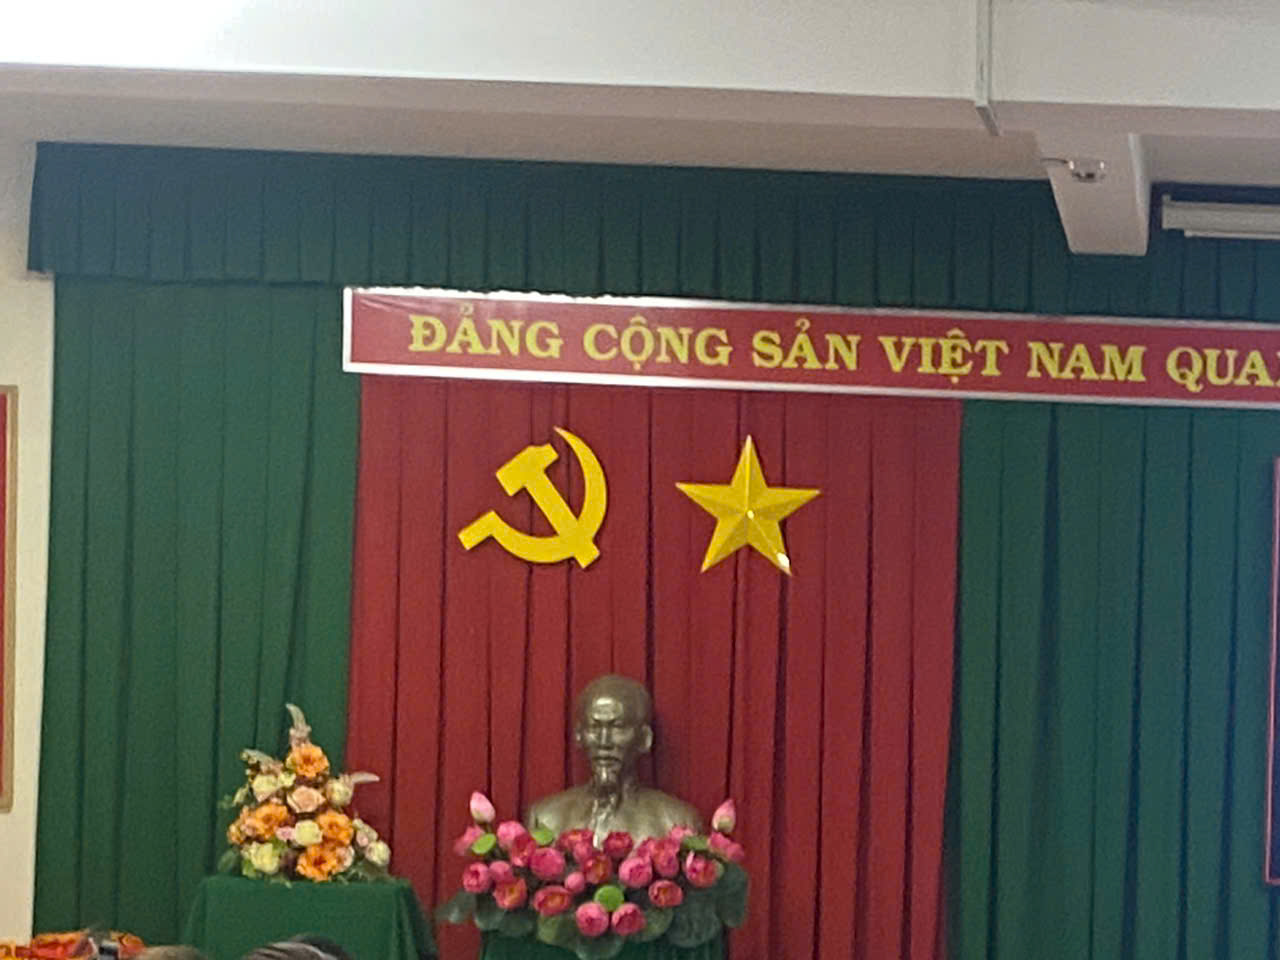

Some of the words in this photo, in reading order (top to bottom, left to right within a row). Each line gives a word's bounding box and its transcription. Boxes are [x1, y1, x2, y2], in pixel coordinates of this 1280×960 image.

[407, 303, 564, 361] ĐẢNG
[583, 315, 733, 370] CỘNG
[752, 317, 861, 371] SẢN
[880, 328, 1009, 384] VIỆT
[1027, 341, 1147, 383] NAM
